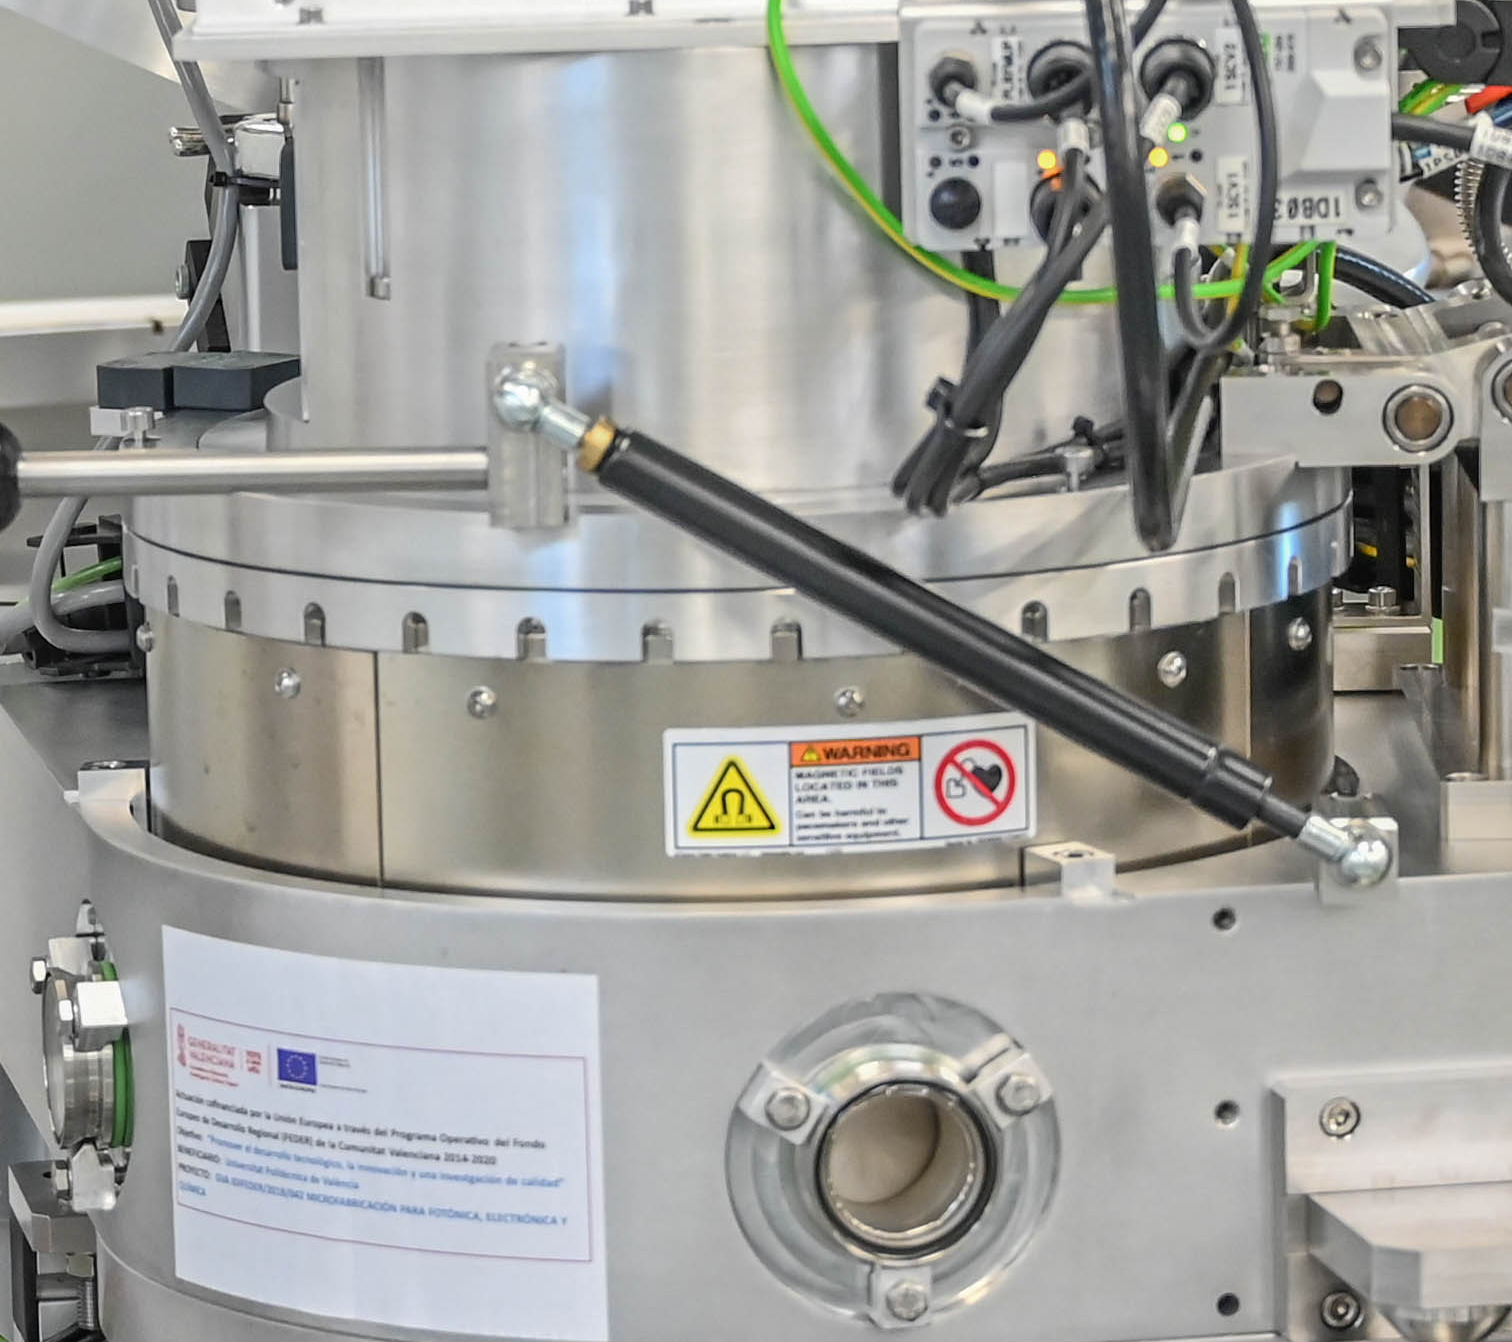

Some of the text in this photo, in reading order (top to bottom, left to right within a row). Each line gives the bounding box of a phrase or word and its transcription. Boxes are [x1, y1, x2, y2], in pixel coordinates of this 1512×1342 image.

[823, 742, 910, 760] WARNING
[795, 766, 903, 778] MAGNETIC FIELDS
[796, 781, 852, 792] LOCATED
[872, 779, 898, 787] THIS
